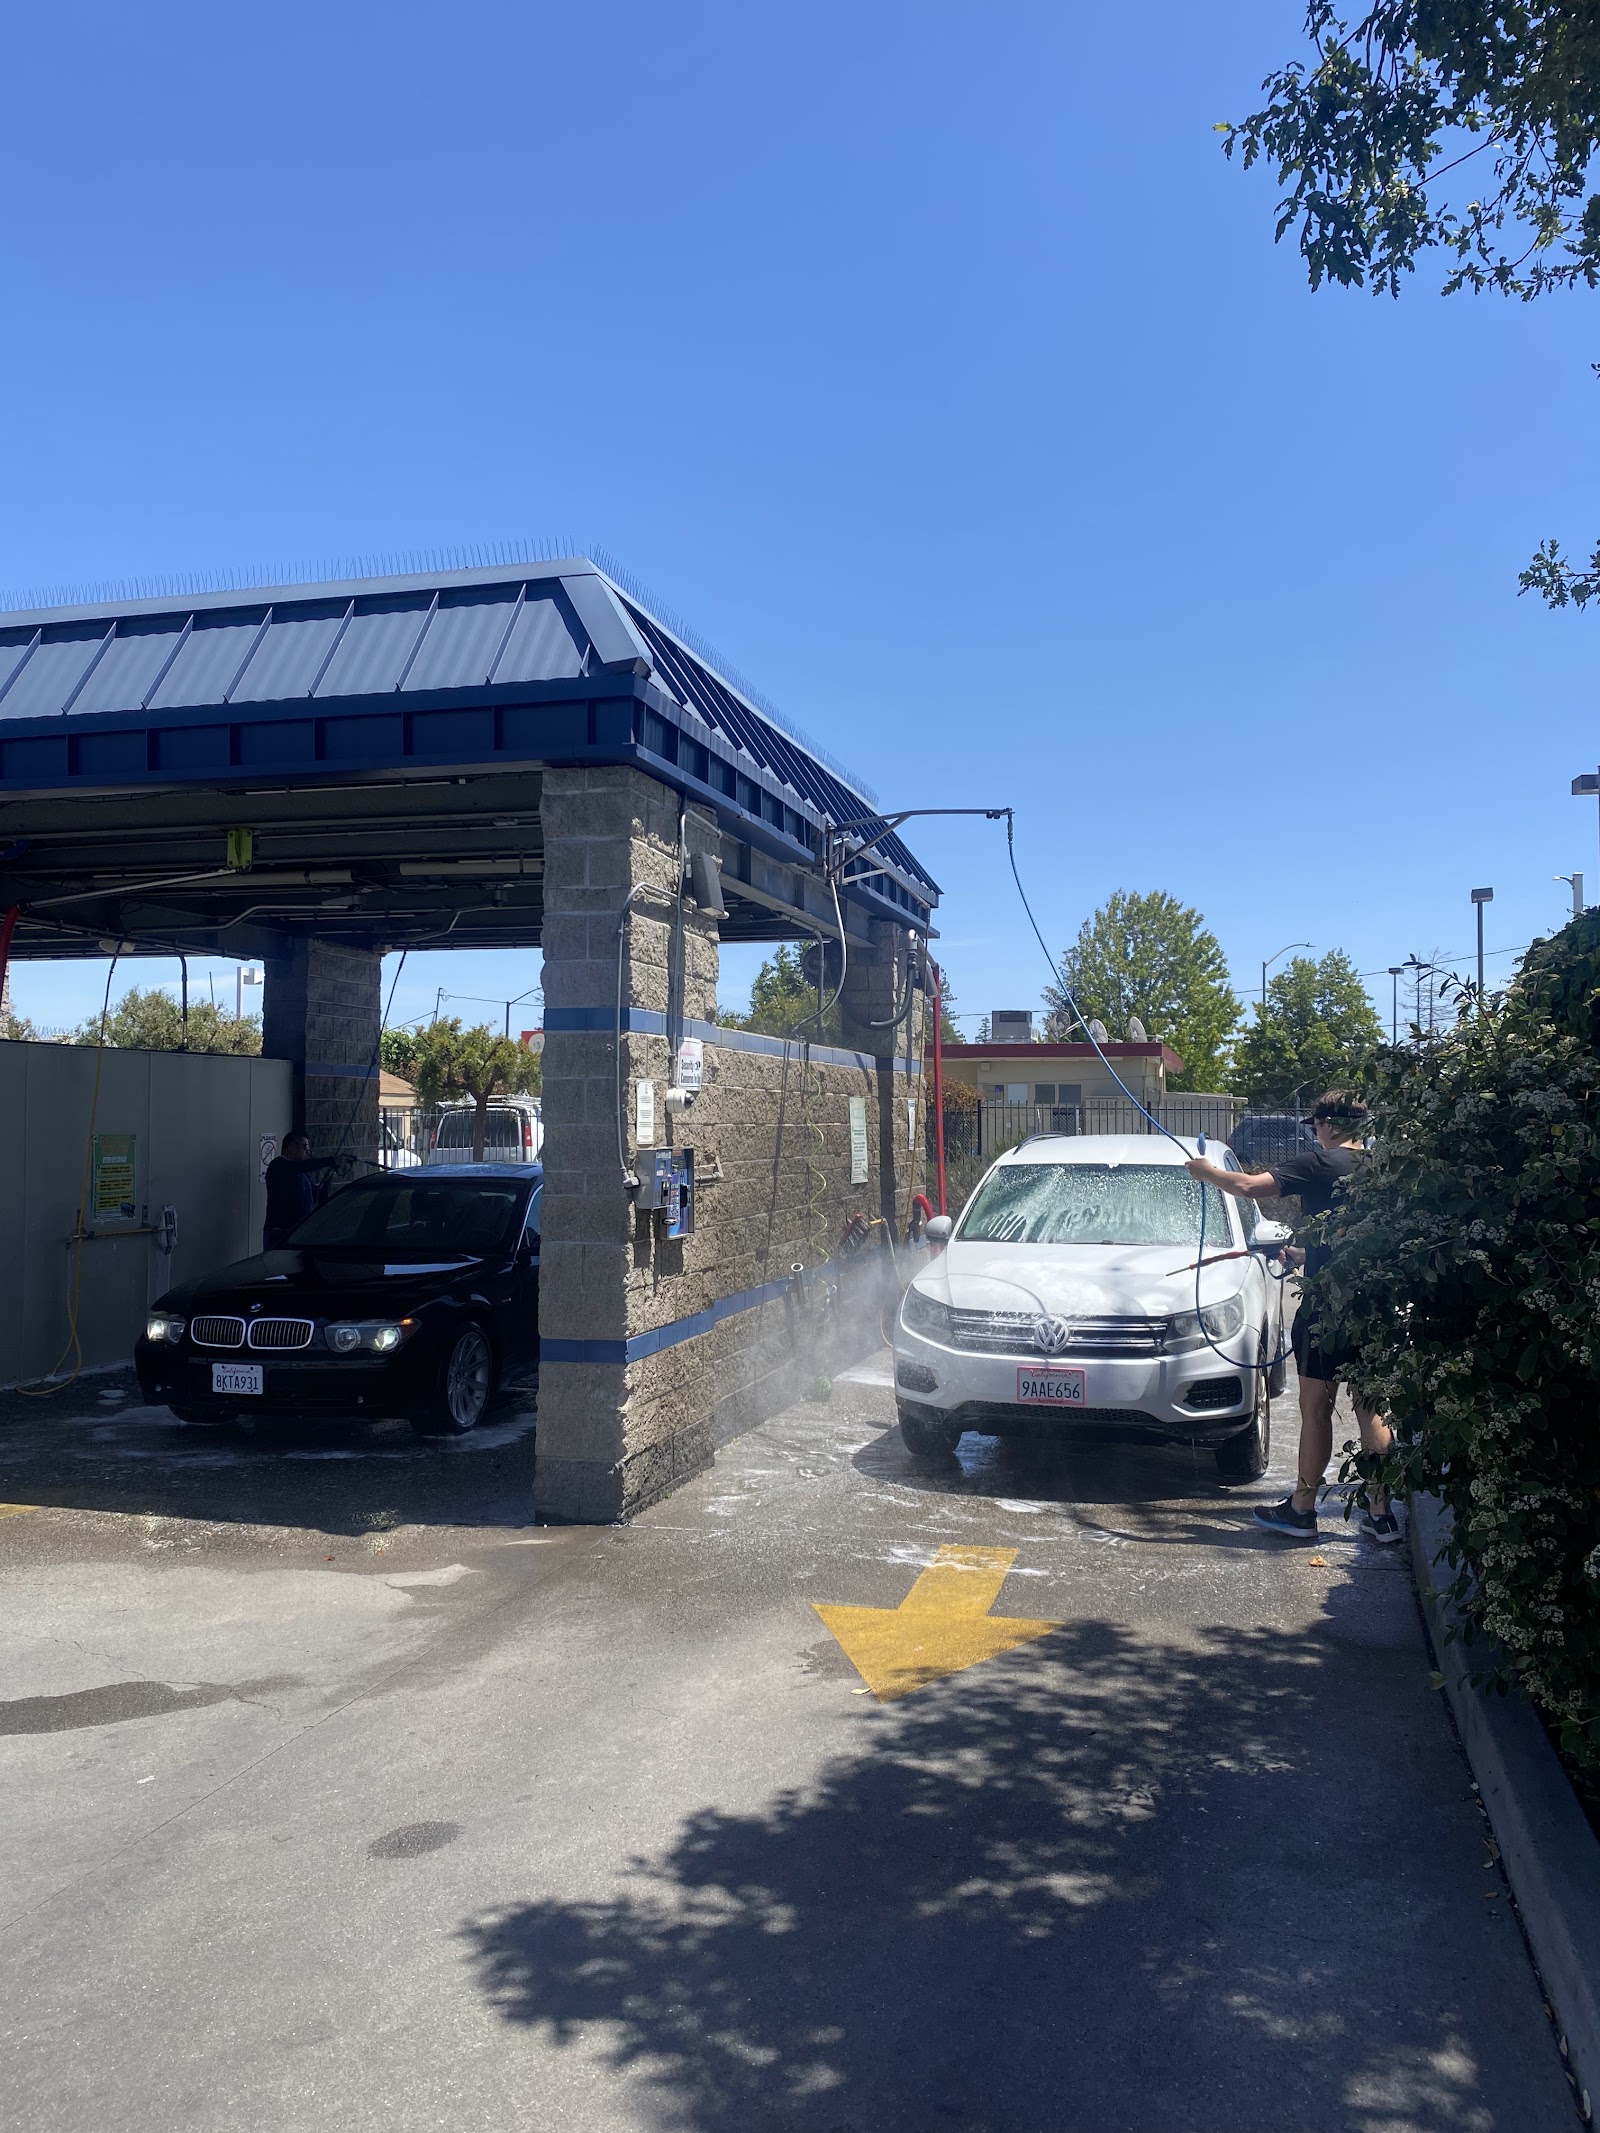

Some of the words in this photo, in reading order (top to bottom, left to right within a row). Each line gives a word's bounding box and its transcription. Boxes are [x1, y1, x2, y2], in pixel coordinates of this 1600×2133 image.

[681, 1059, 694, 1073] Security
[102, 1155, 128, 1165] menu
[223, 1366, 251, 1376] California
[1030, 1370, 1070, 1380] California
[216, 1374, 259, 1390] 8KTA931
[1022, 1381, 1080, 1399] 9AAE656
